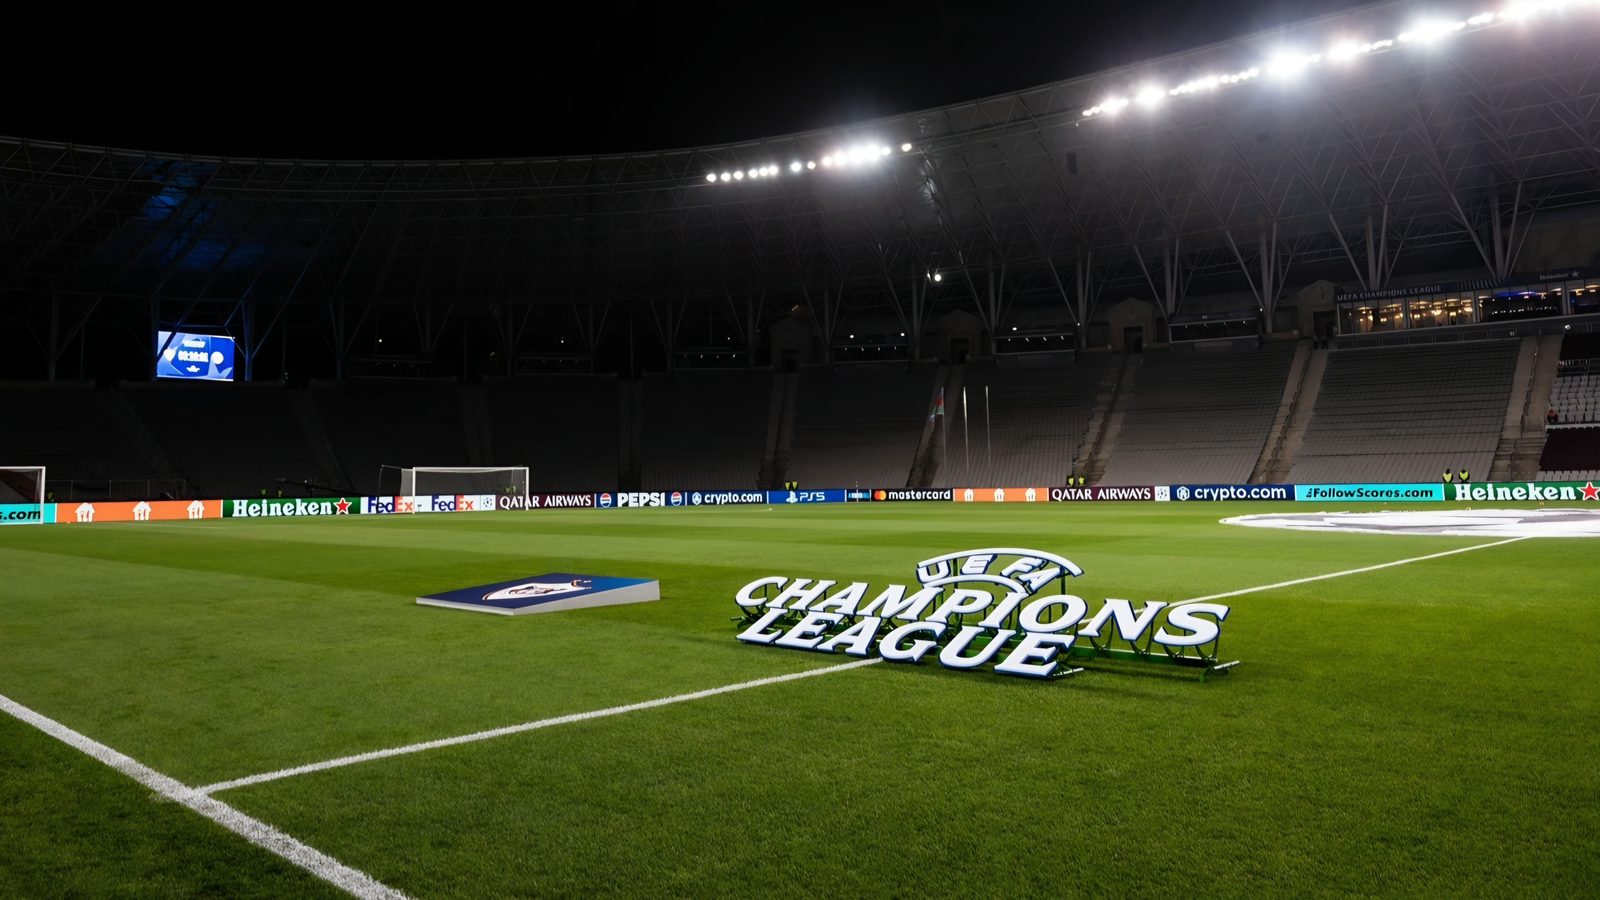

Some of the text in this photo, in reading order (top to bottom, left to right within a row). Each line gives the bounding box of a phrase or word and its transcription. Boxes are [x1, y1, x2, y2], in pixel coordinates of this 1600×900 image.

[1337, 285, 1441, 301] UEFA CHAMPIONS LEAGUE
[704, 492, 763, 506] crypto.com
[799, 491, 826, 502] PS5
[888, 489, 951, 501] mastercard
[1052, 487, 1151, 502] QATAR AIRWAYS
[1194, 486, 1286, 502] crypto.com
[1454, 483, 1577, 500] Heineken
[367, 496, 413, 513] FedEx
[431, 495, 474, 512] FedEx
[500, 494, 592, 510] QATAR AIRWAYS
[618, 492, 665, 508] PEPSI
[233, 499, 333, 518] Heineken
[917, 554, 1061, 593] UEFA
[735, 576, 1230, 648] CHAMPIONS
[736, 608, 1077, 678] LEAGUE
